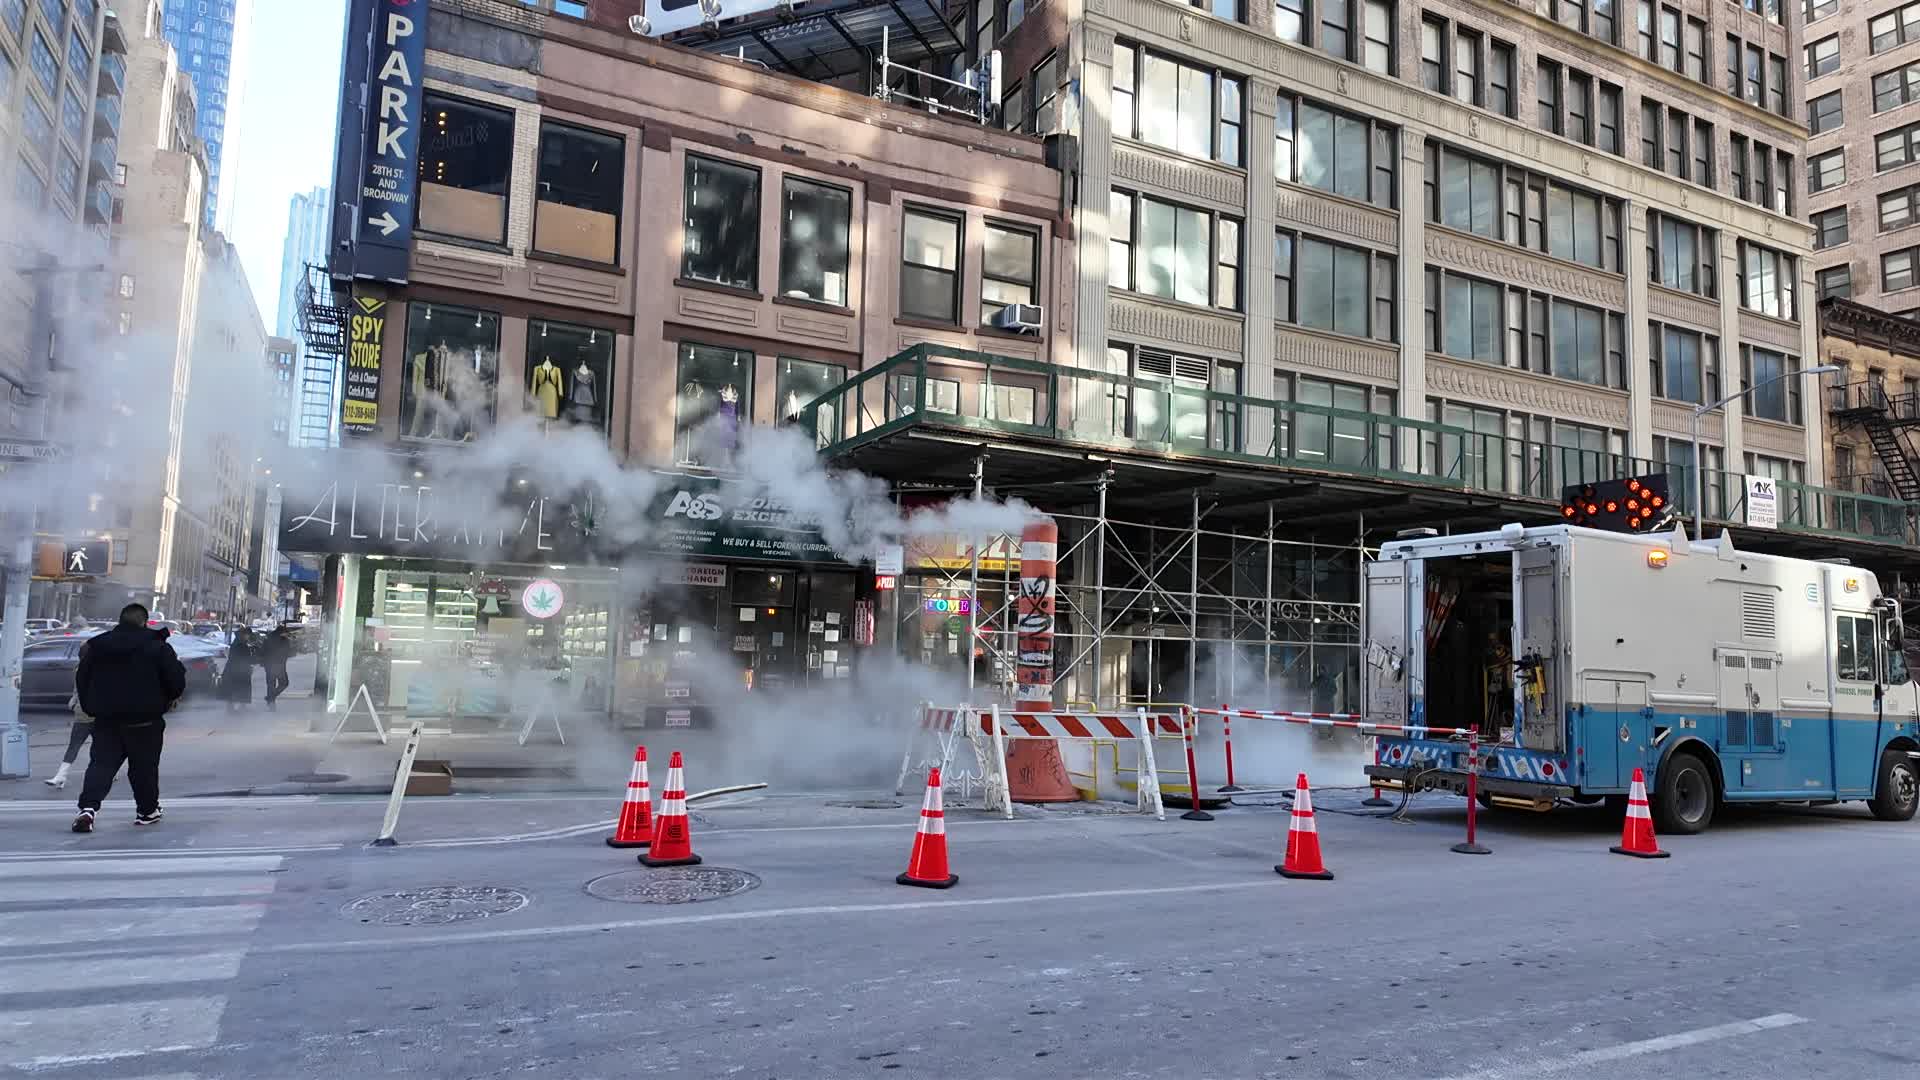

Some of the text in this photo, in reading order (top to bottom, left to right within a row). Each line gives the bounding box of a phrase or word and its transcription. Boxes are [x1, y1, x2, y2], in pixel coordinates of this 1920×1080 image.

[378, 13, 414, 159] PARK
[372, 164, 405, 180] 28TH ST.
[378, 177, 397, 190] AND
[363, 186, 409, 204] BROADWAY
[351, 314, 384, 343] SPY
[350, 341, 380, 369] STORE
[0, 445, 58, 457] NE WAY
[664, 490, 721, 520] A&S
[722, 537, 734, 546] WE
[735, 539, 749, 547] BUY
[756, 540, 771, 549] SELL
[772, 542, 801, 551] FOREIGN
[802, 543, 833, 553] CURRENC
[690, 567, 725, 576] OREIGN
[1247, 600, 1301, 620] KINGS
